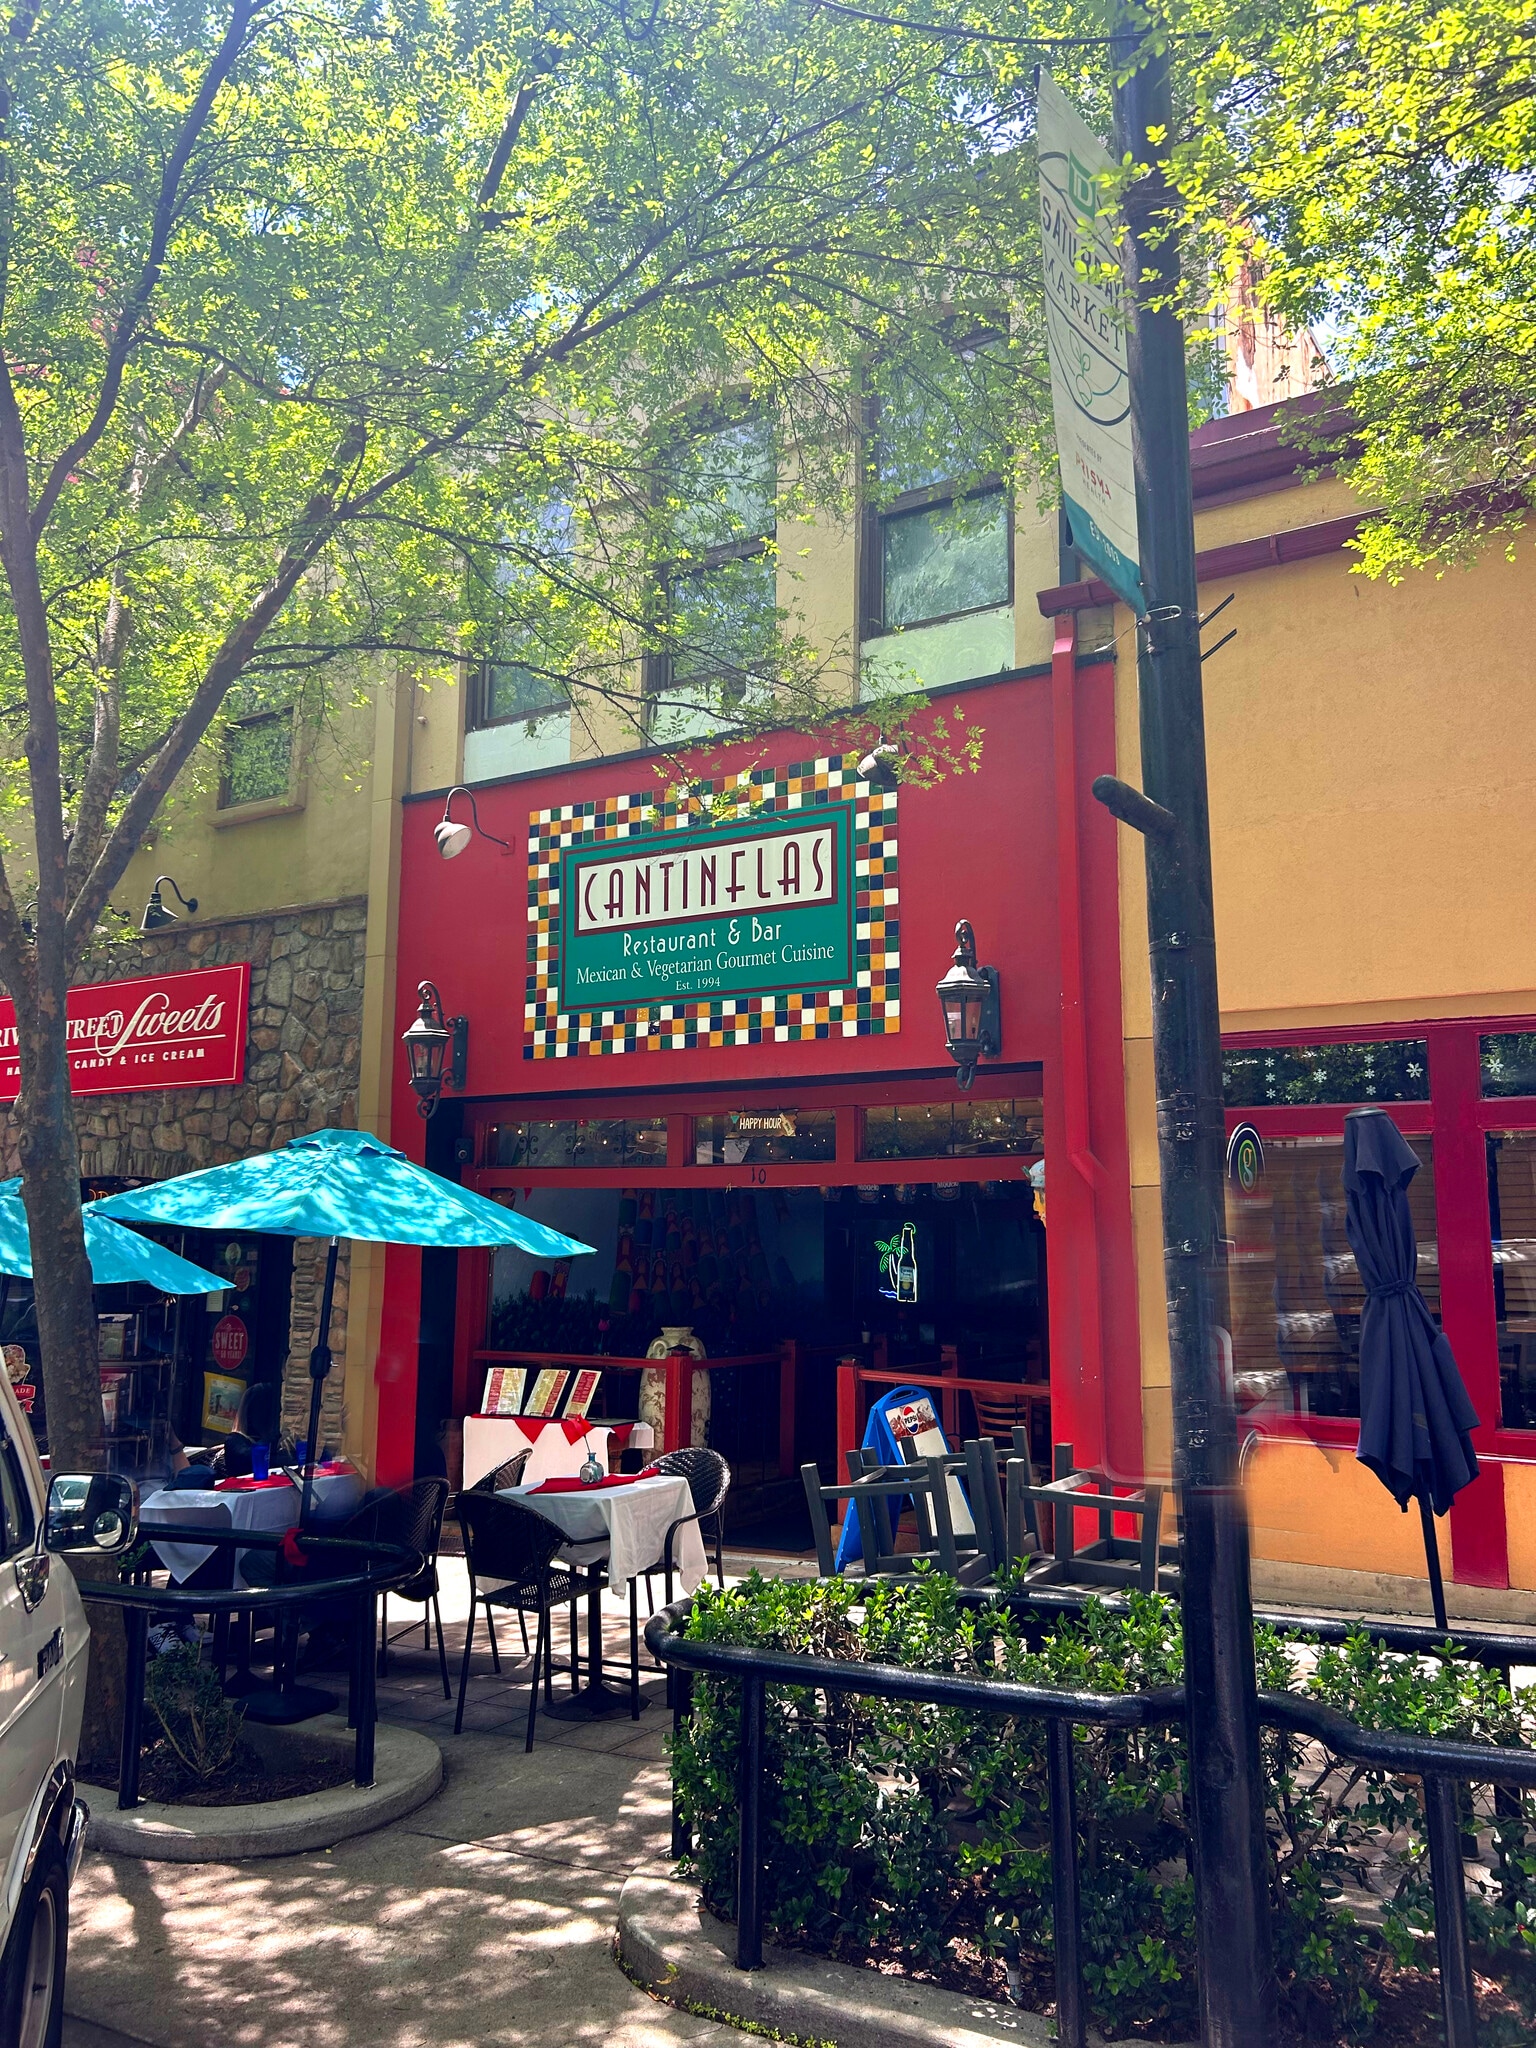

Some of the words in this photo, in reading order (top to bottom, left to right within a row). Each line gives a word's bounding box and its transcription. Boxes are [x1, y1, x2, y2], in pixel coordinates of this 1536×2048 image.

[1043, 244, 1122, 352] MARKET
[585, 838, 824, 922] CANTINFLAS
[623, 928, 716, 957] Restaurant
[728, 918, 741, 945] &
[752, 917, 782, 943] Bar
[576, 965, 627, 985] Mexican
[631, 962, 643, 979] &
[647, 956, 712, 982] Vegetarian
[716, 949, 777, 970] Gourmet
[781, 943, 835, 963] Cuisine
[676, 980, 693, 991] Est.
[697, 976, 721, 989] 1994
[66, 1014, 123, 1040] TREET
[95, 992, 226, 1057] Sweets
[74, 1057, 113, 1070] CANDY
[119, 1055, 127, 1065] &
[135, 1053, 155, 1064] ICE
[162, 1048, 205, 1062] CREAM
[739, 1117, 763, 1130] HAPPY
[763, 1117, 782, 1129] HOUR
[751, 1166, 767, 1185] 10
[215, 1332, 244, 1350] SWEET
